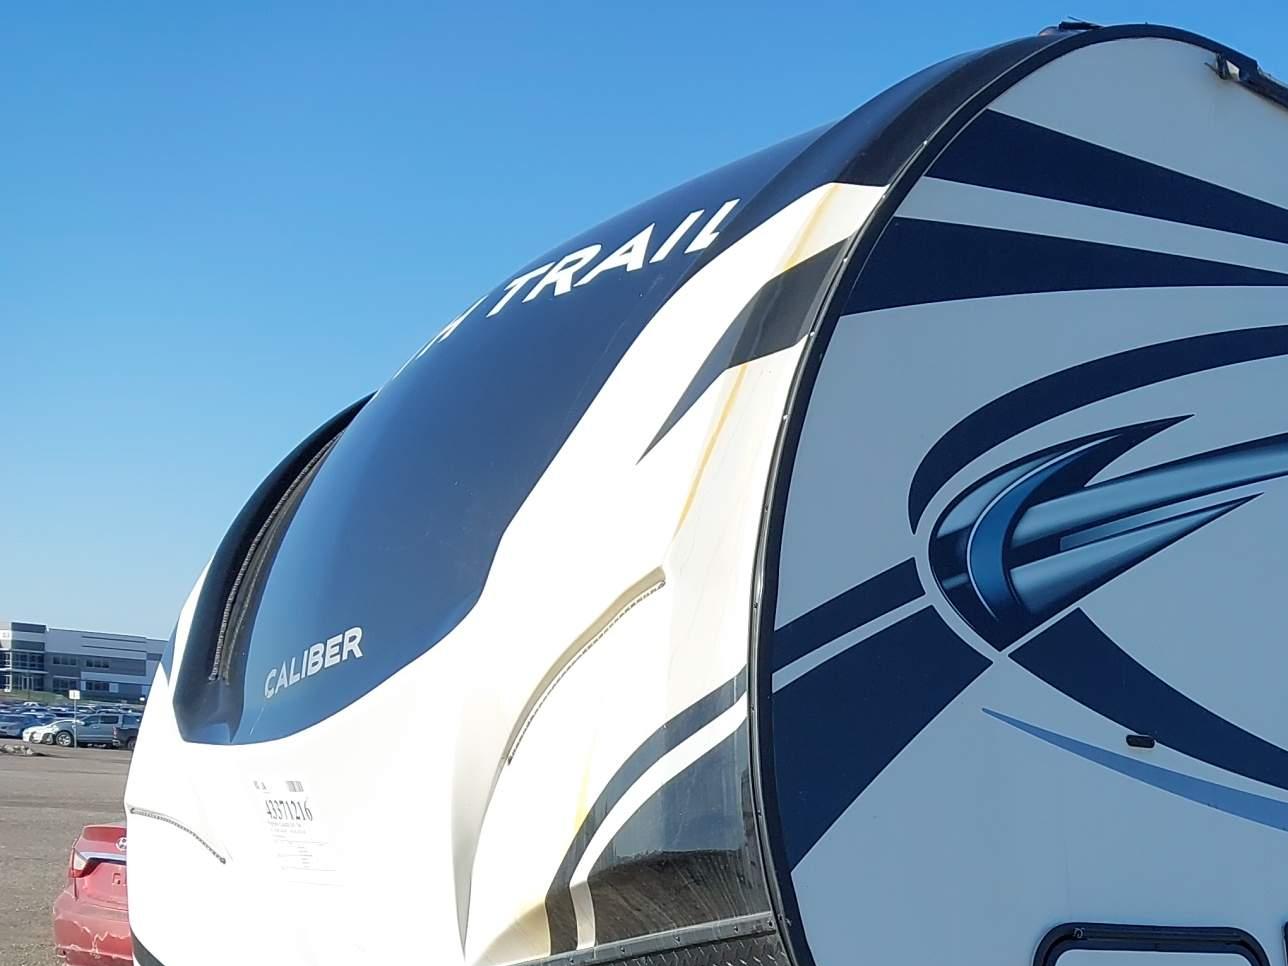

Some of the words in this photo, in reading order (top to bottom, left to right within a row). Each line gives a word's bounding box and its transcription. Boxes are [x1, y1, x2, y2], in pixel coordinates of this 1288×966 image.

[486, 198, 740, 318] TRAIL
[264, 627, 364, 699] CALIBER
[265, 800, 313, 822] 43371216
